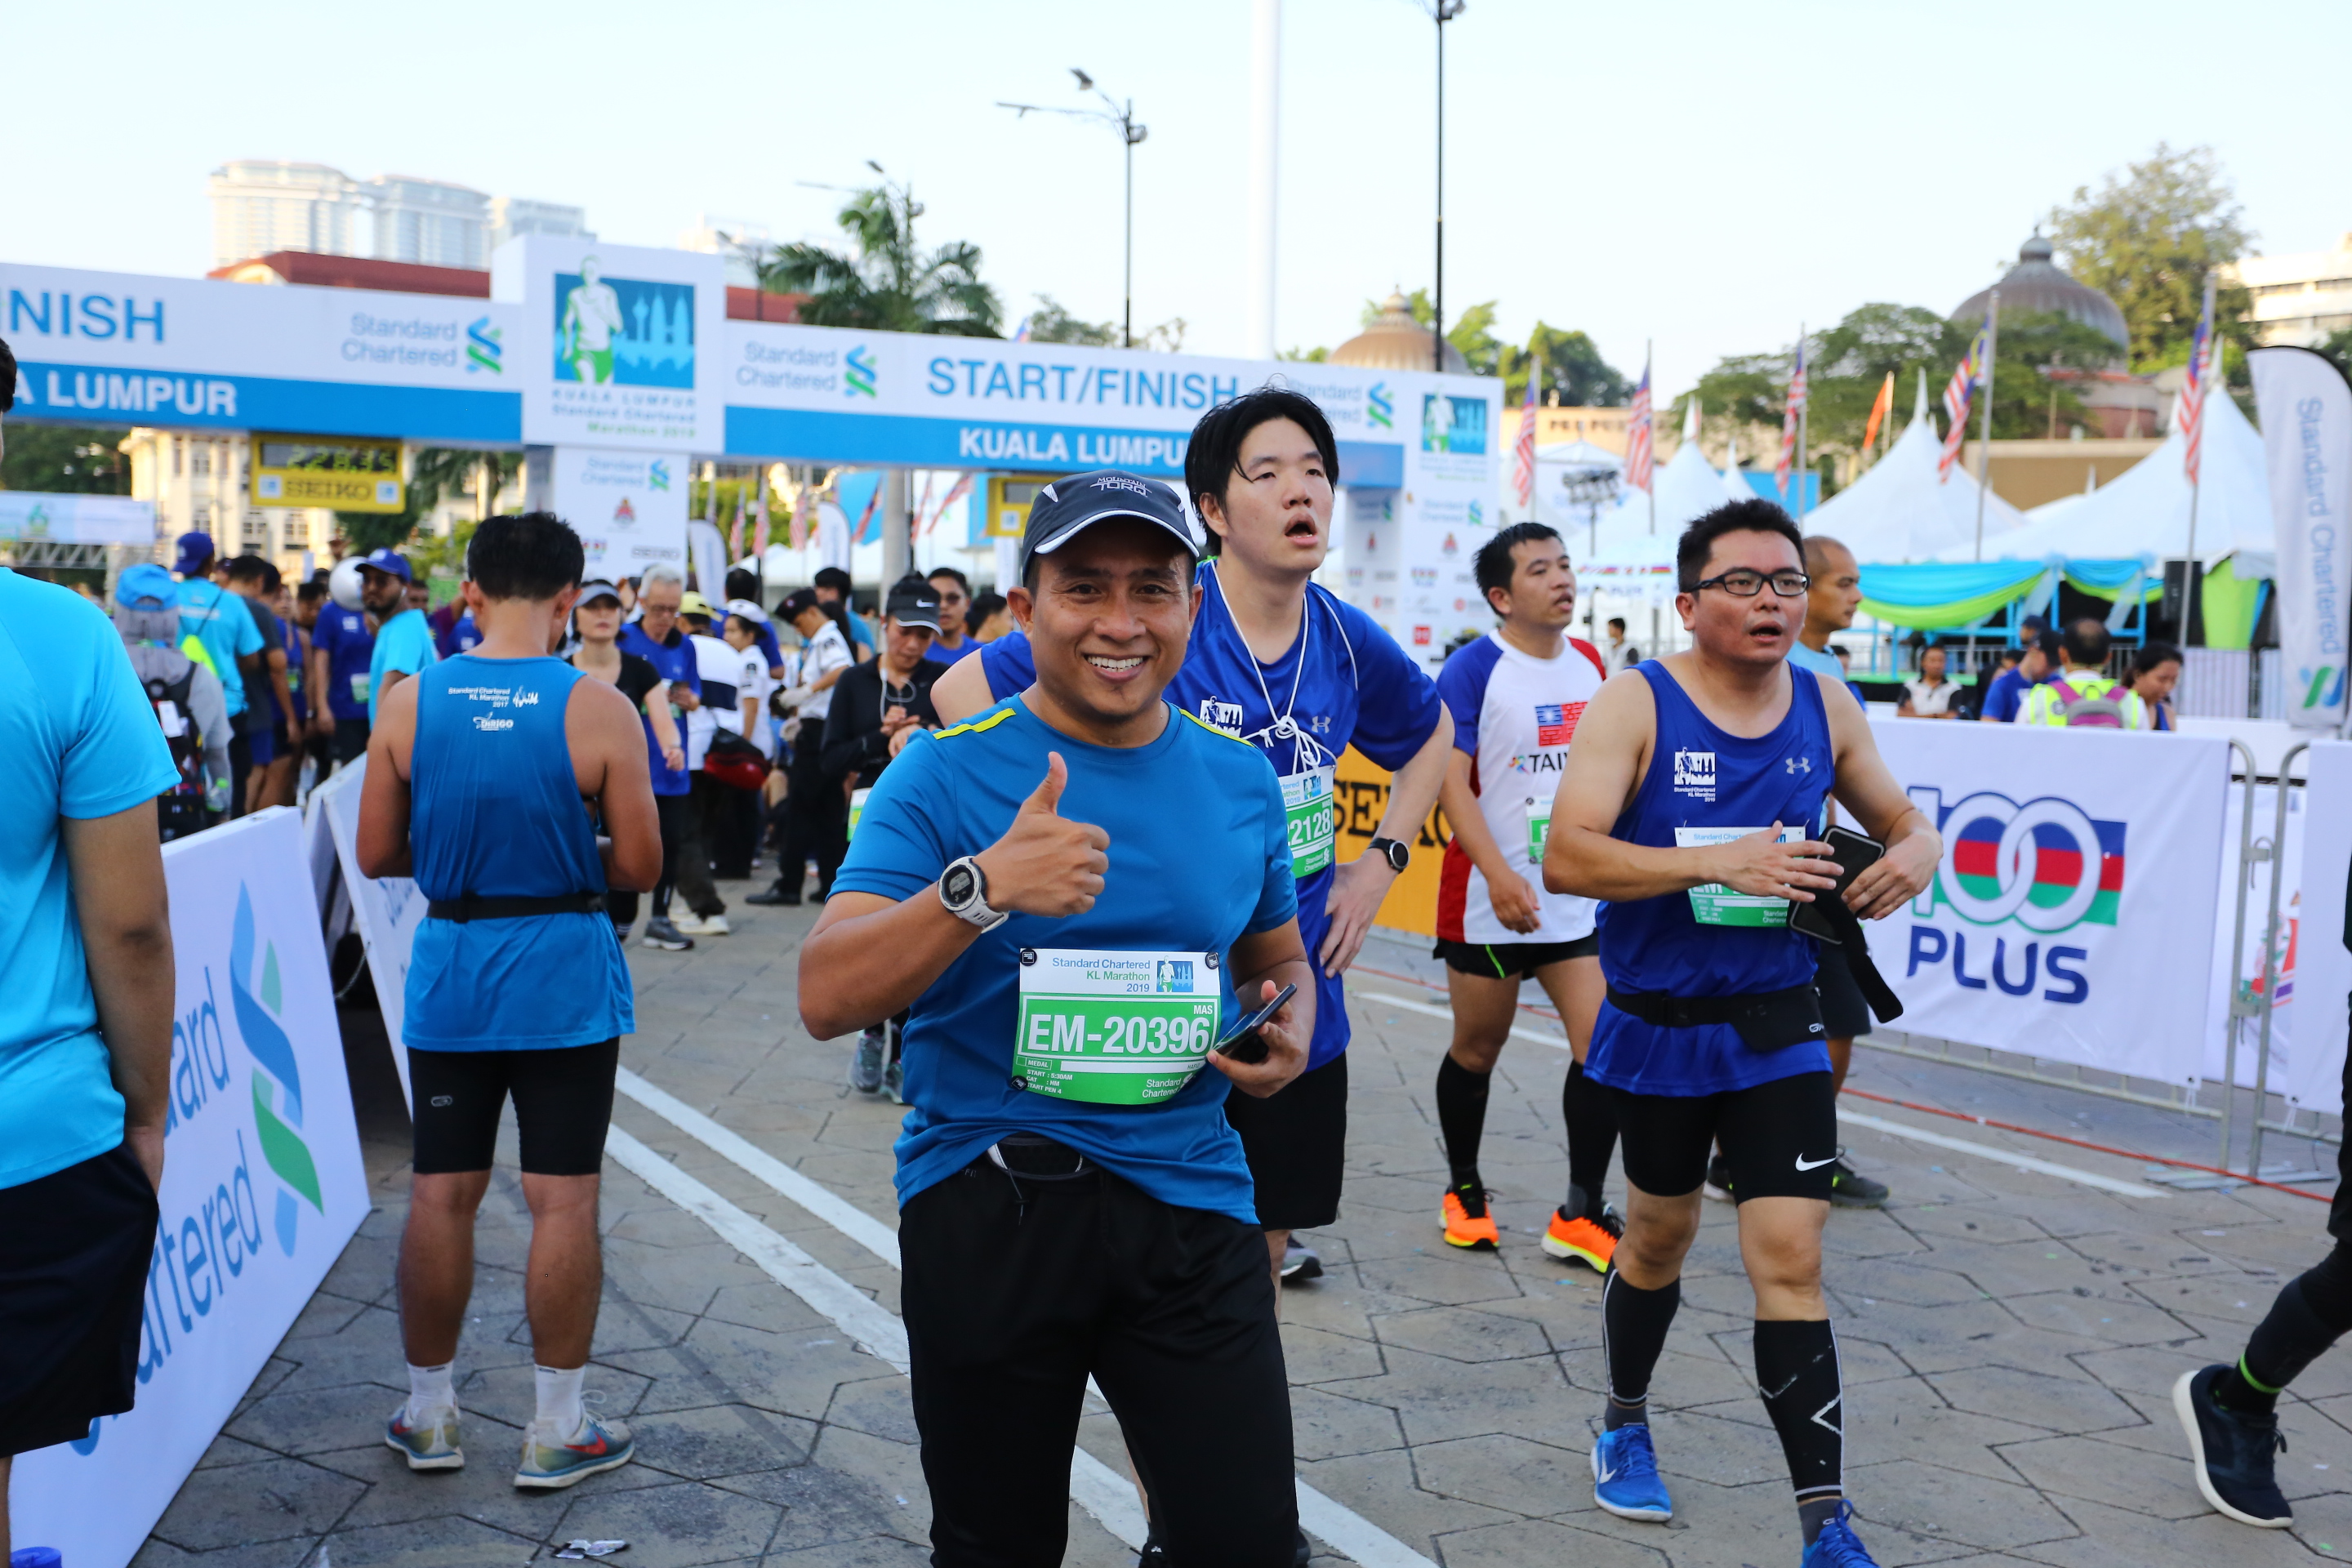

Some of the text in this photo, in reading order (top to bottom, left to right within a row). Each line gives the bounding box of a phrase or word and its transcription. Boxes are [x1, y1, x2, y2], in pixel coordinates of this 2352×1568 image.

[350, 312, 457, 342] Standard
[341, 338, 457, 368] Chartered
[744, 340, 837, 368] Standard
[736, 364, 837, 392] Chartered
[927, 356, 1239, 410] START/FINISH
[47, 369, 238, 417] LUMPUR
[552, 387, 696, 408] KUALA LUMPUR
[552, 403, 696, 423] Standard Chartered
[586, 421, 657, 437] Marathon
[958, 426, 1190, 470] KUALA LUMPU
[286, 479, 372, 501] SEIKO
[1093, 481, 1149, 498] TORQ
[1097, 477, 1146, 488] MOUNTAIN
[2295, 395, 2344, 655] Standard Chartered
[448, 687, 510, 696] Standard Chartered
[479, 694, 510, 702] Marathon
[1529, 752, 1568, 773] TAI
[1286, 796, 1300, 805] 2019
[1287, 808, 1332, 847] 2128
[1907, 785, 2103, 934] 100
[1052, 957, 1151, 970] Standard Chartered
[1906, 924, 2089, 1004] PLUS
[1087, 971, 1150, 982] KL Marathon
[1126, 983, 1150, 993] 2019
[1193, 1005, 1213, 1015] MAS
[1027, 1013, 1211, 1054] EM-20396
[1028, 1060, 1048, 1068] MEDAL
[1147, 1078, 1181, 1088] Standard
